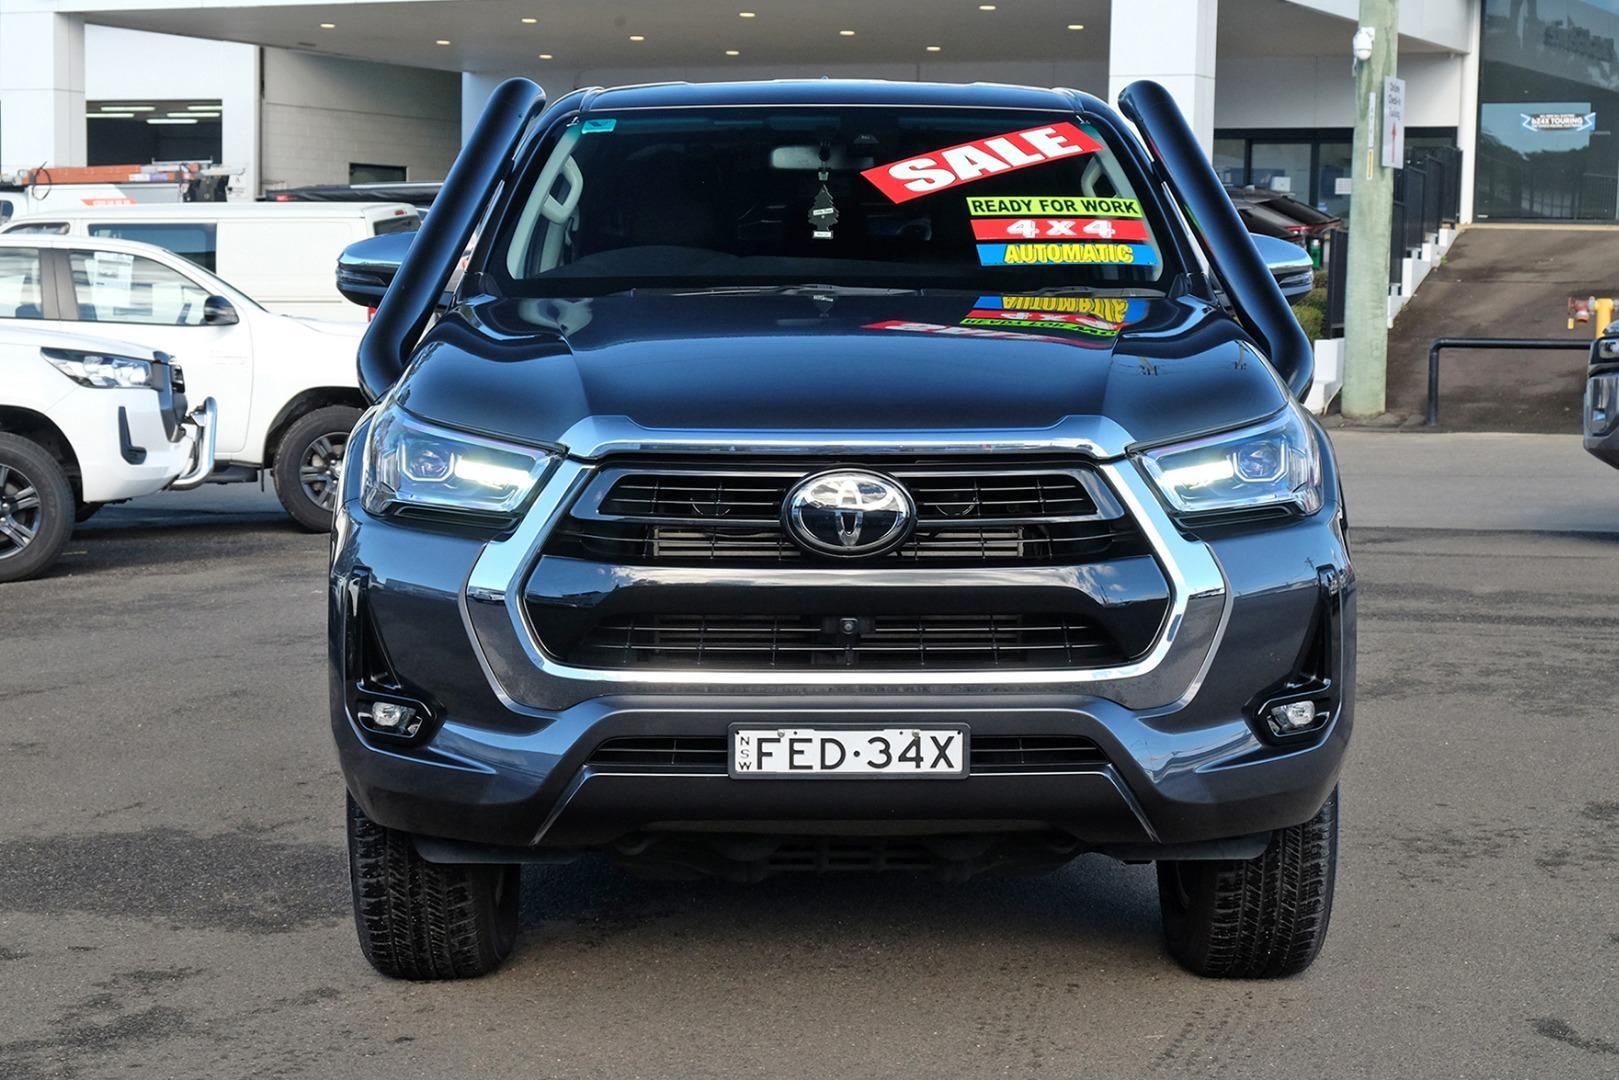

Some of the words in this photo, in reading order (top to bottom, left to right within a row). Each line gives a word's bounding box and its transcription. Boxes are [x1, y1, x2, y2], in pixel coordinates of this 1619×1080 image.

[888, 127, 1084, 192] SALE
[972, 199, 1032, 213] READY
[1041, 199, 1077, 213] FOR
[1083, 199, 1139, 214] WORK
[1004, 243, 1134, 264] AUTOMATIC
